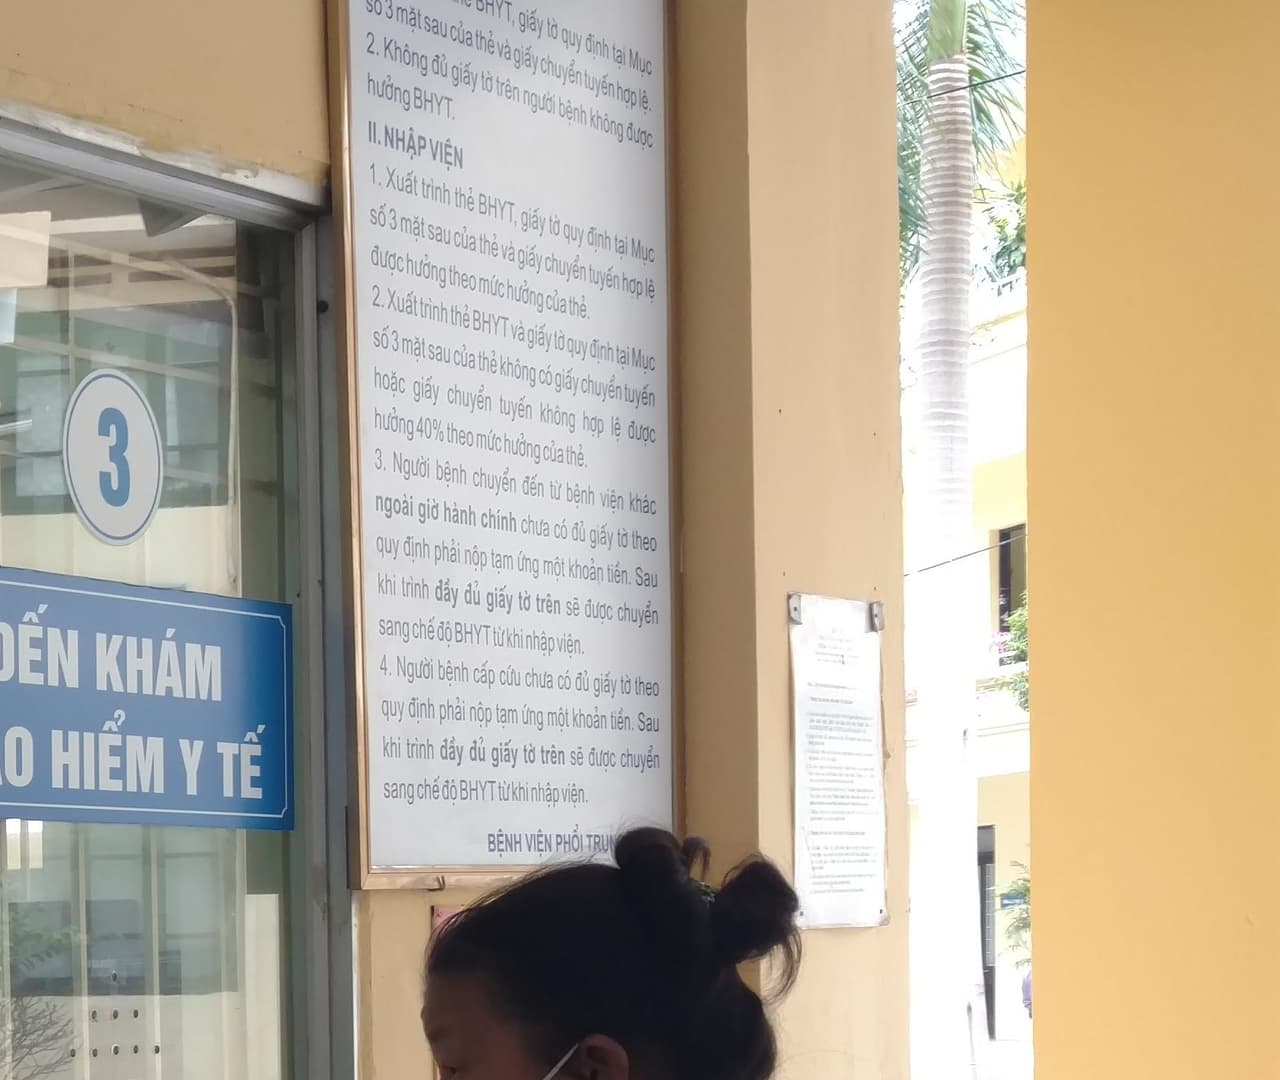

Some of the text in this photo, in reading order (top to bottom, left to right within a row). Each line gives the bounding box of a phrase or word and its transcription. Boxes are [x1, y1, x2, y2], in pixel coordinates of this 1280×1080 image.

[366, 31, 653, 151] 2. Không đủ giấy tờ trên người bệnh không được
[368, 120, 464, 172] II. NHẬP VIỆN
[370, 244, 590, 320] được hưởng theo mức hưởng của thẻ.
[373, 365, 657, 447] hoặc giấy chuyển tuyến không hợp lệ được
[97, 407, 131, 508] 3
[374, 447, 657, 516] 3. Người bệnh chuyển đến từ bệnh viện khác
[375, 493, 657, 552] ngoài giờ hành chính chưa có đủ giấy tờ theo
[377, 572, 659, 629] khi trình đầy đủ giấy tờ trên sẽ được chuyển
[95, 628, 222, 702] KHÁM
[51, 709, 165, 794] HIỂM
[178, 738, 204, 796] Y
[216, 724, 267, 800] TẾ
[487, 823, 617, 853] BỆNH VIỆN PHỔI TRUN
